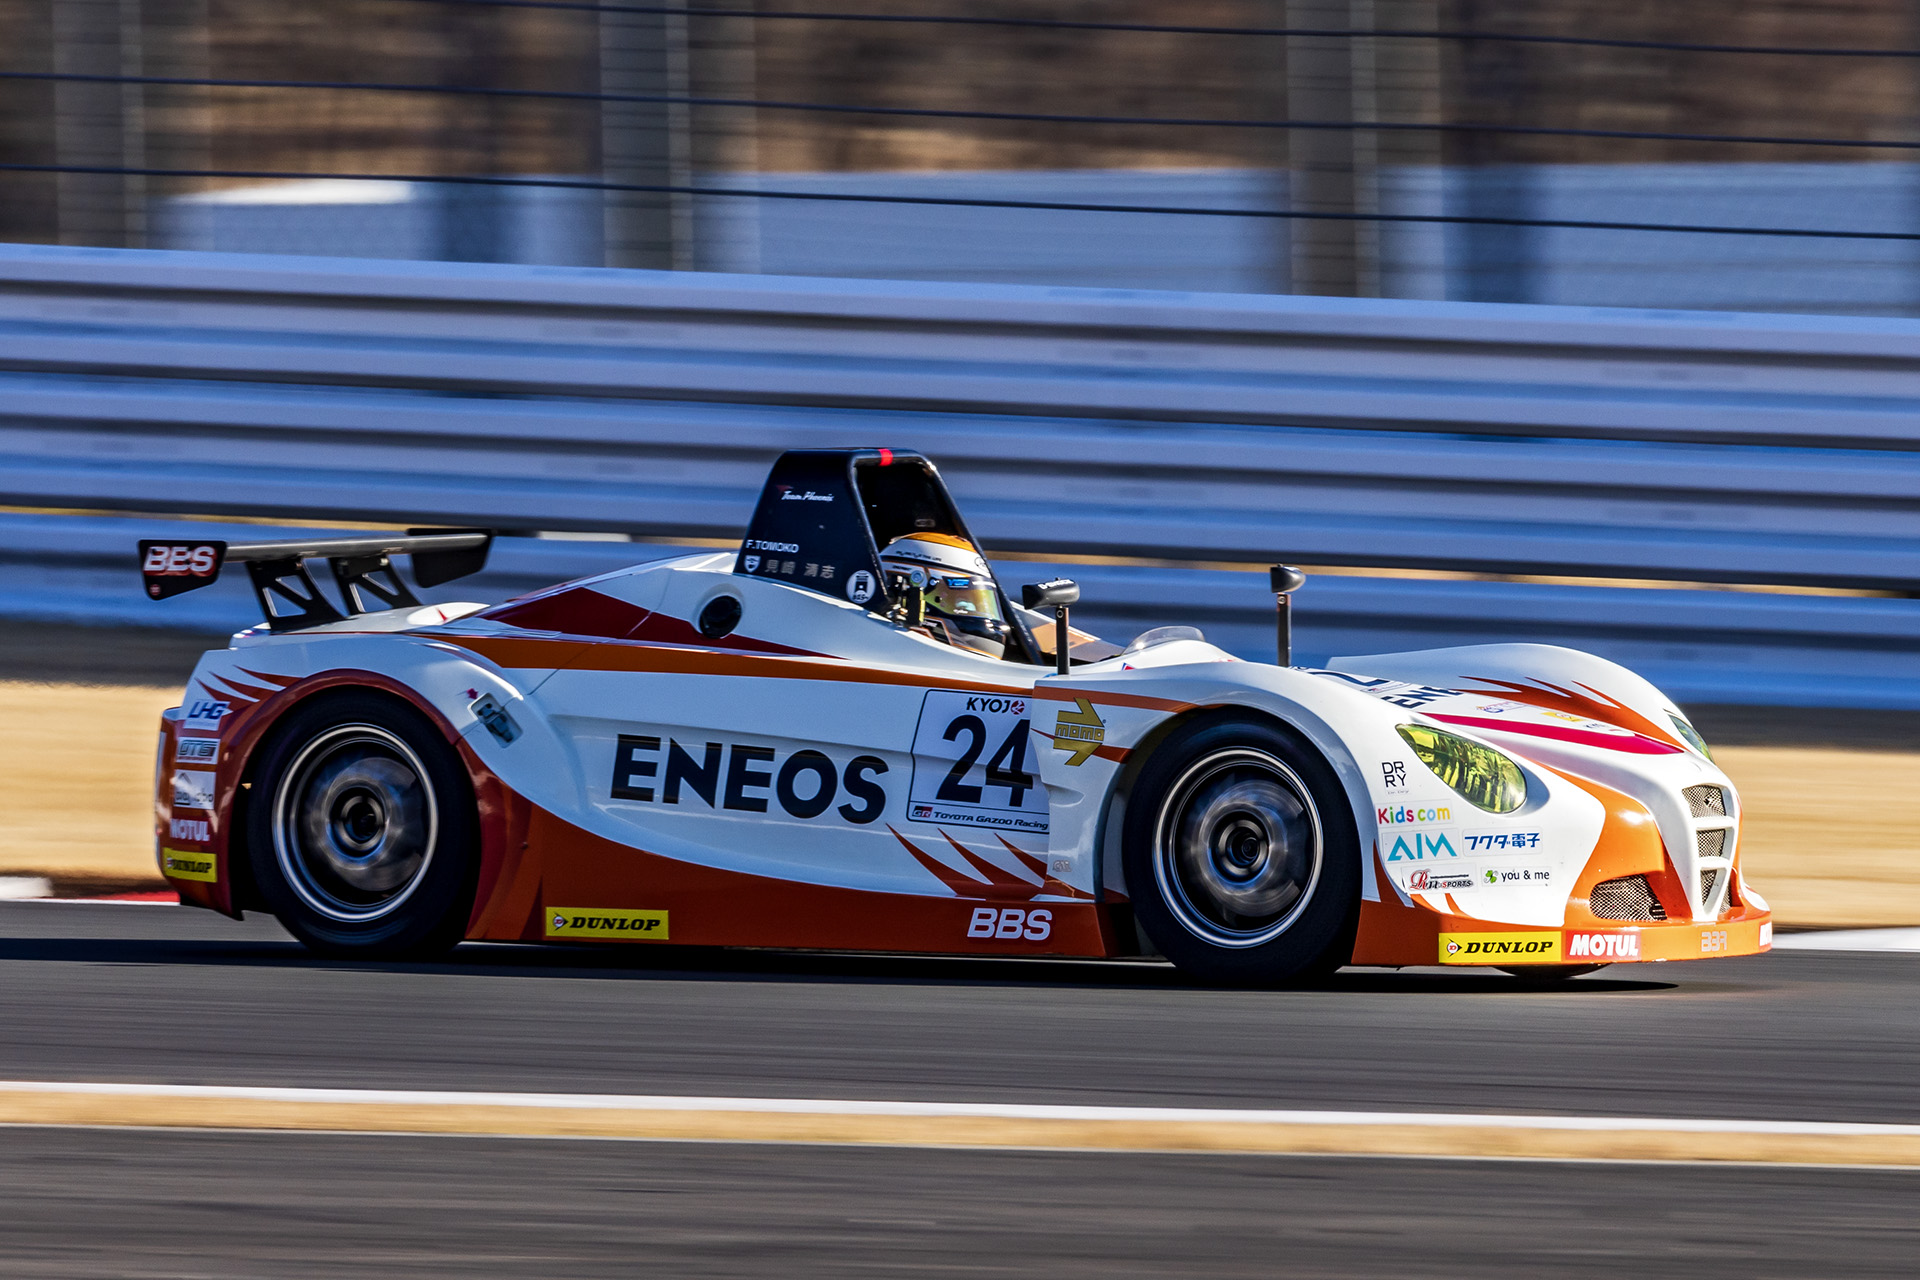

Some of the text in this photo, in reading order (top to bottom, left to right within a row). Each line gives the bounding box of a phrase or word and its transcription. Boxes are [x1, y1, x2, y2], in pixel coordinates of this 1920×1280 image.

[745, 539, 799, 553] F.TOMOKO
[935, 714, 1034, 807] 24
[610, 734, 889, 825] ENEOS
[170, 818, 210, 842] MOTUL
[933, 811, 1049, 831] TOYOTA GAZOO Racing
[1464, 833, 1540, 850] フクダ電子
[1501, 869, 1550, 882] you & me
[569, 916, 660, 931] DUNLOP
[967, 908, 1053, 941] BBS
[1464, 941, 1553, 954] DUNLOP
[1569, 934, 1639, 956] MOTUL
